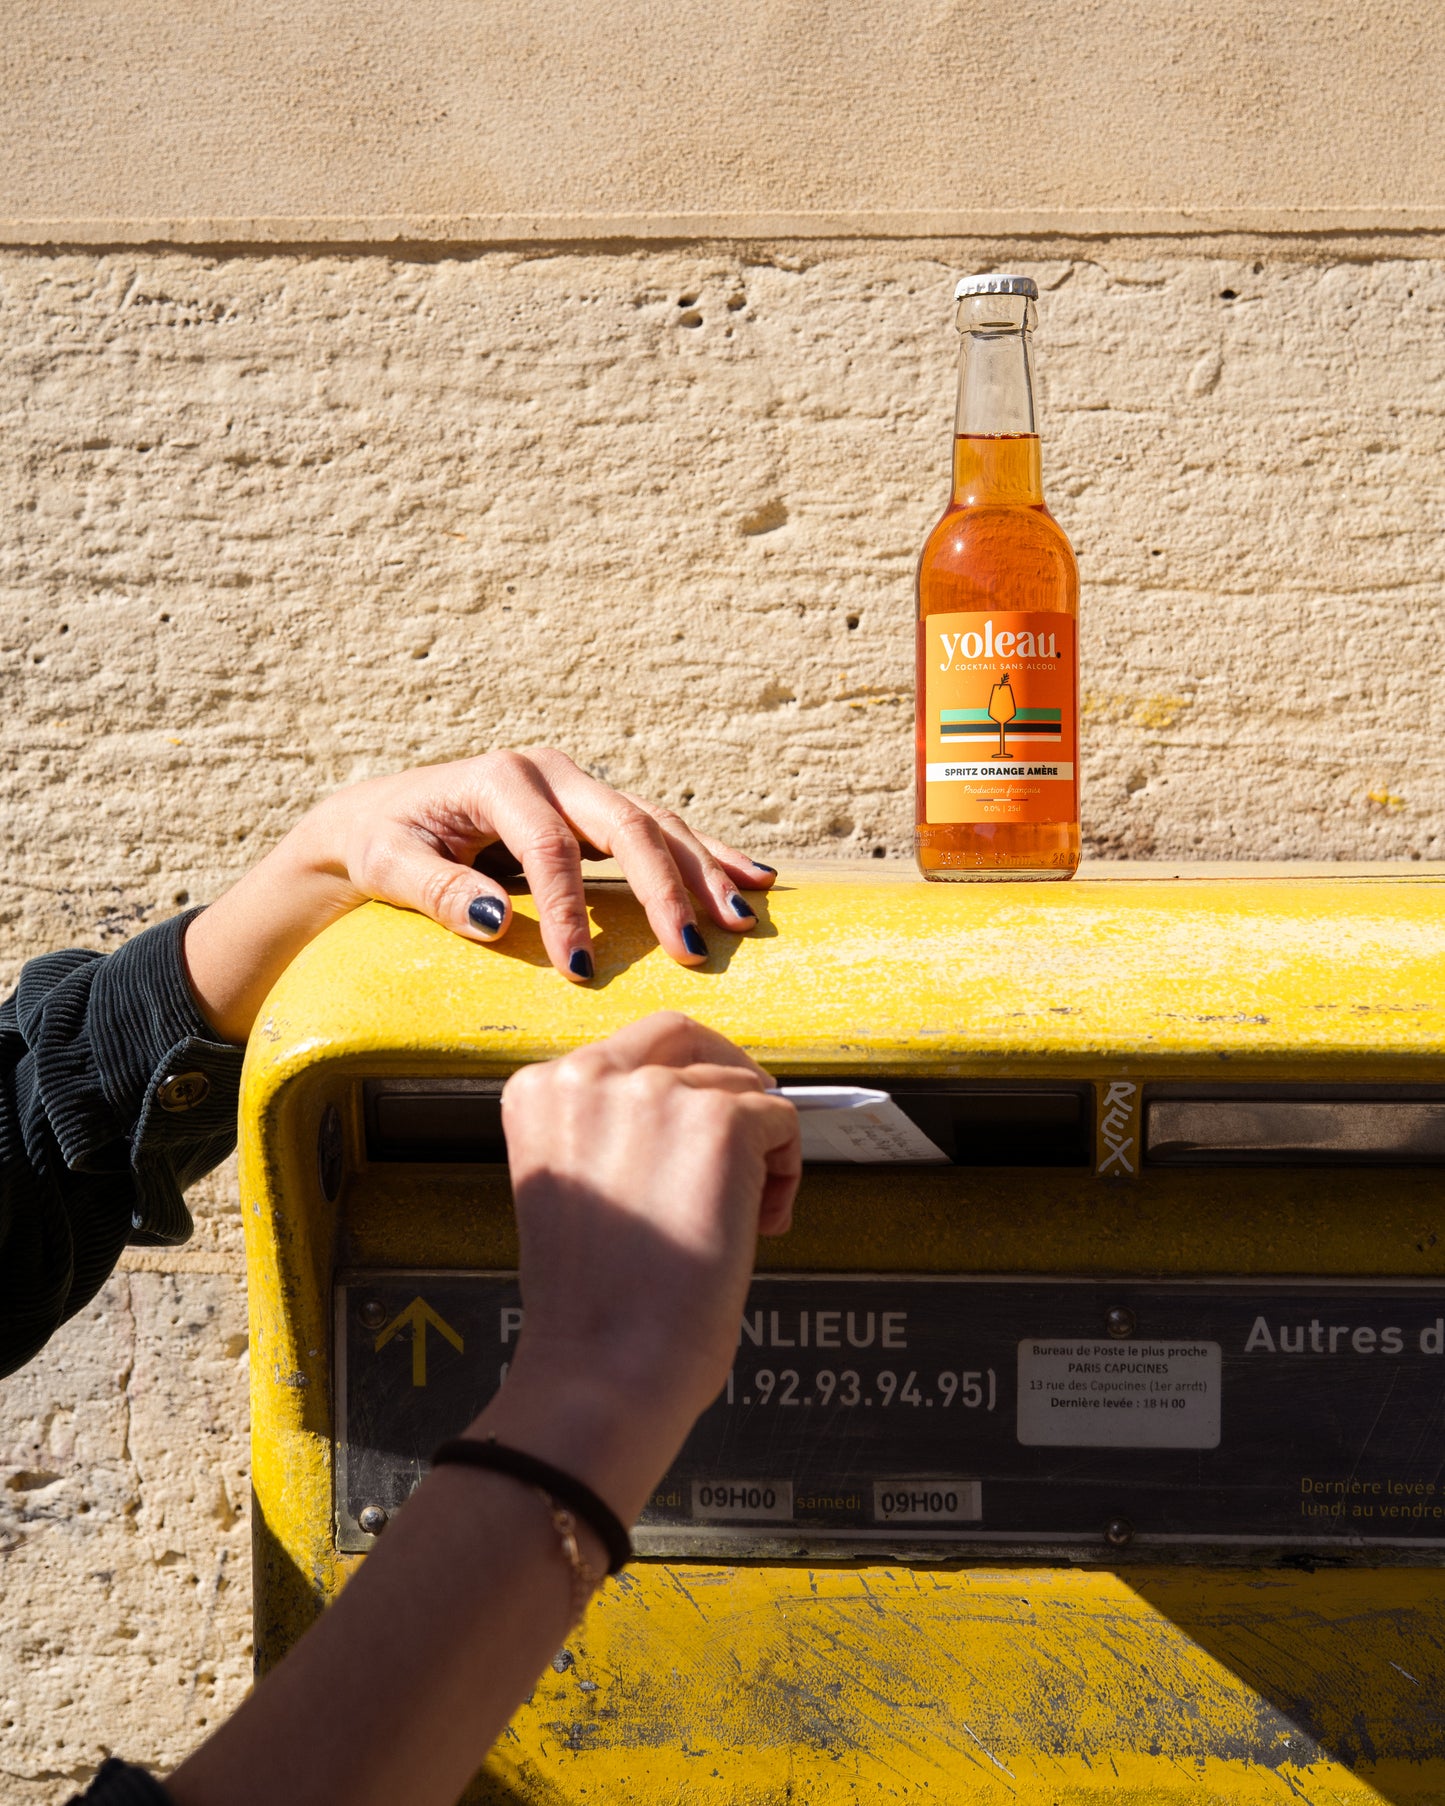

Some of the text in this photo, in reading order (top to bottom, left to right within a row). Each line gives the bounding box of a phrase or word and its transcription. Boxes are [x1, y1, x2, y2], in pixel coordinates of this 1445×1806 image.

[955, 663, 996, 671] COCKTAIL
[1026, 663, 1057, 671] ALCOOL
[945, 765, 1058, 776] SPRITZ ORANGE AMÈRE
[963, 785, 1041, 797] Production française
[740, 1310, 908, 1348] NLIEUE
[1244, 1316, 1403, 1354] Autres
[1033, 1345, 1208, 1359] Bureau de Poste le plus proche
[1068, 1363, 1169, 1374] PARIS CAPUCINES
[726, 1368, 998, 1411] 1.92.93.94.95)
[1030, 1380, 1208, 1393] 13 rue des Capucines (1er arrdt)
[1051, 1397, 1100, 1408] Dernière
[1103, 1397, 1133, 1408] levée
[1143, 1398, 1157, 1408] 18
[1160, 1398, 1169, 1408] H
[1171, 1398, 1186, 1408] 00
[1300, 1475, 1381, 1495] Dernière
[1387, 1478, 1436, 1495] levée
[648, 1486, 958, 1513] redi 09H00 samedi 09H00
[1300, 1501, 1445, 1518] lundi au vendre
